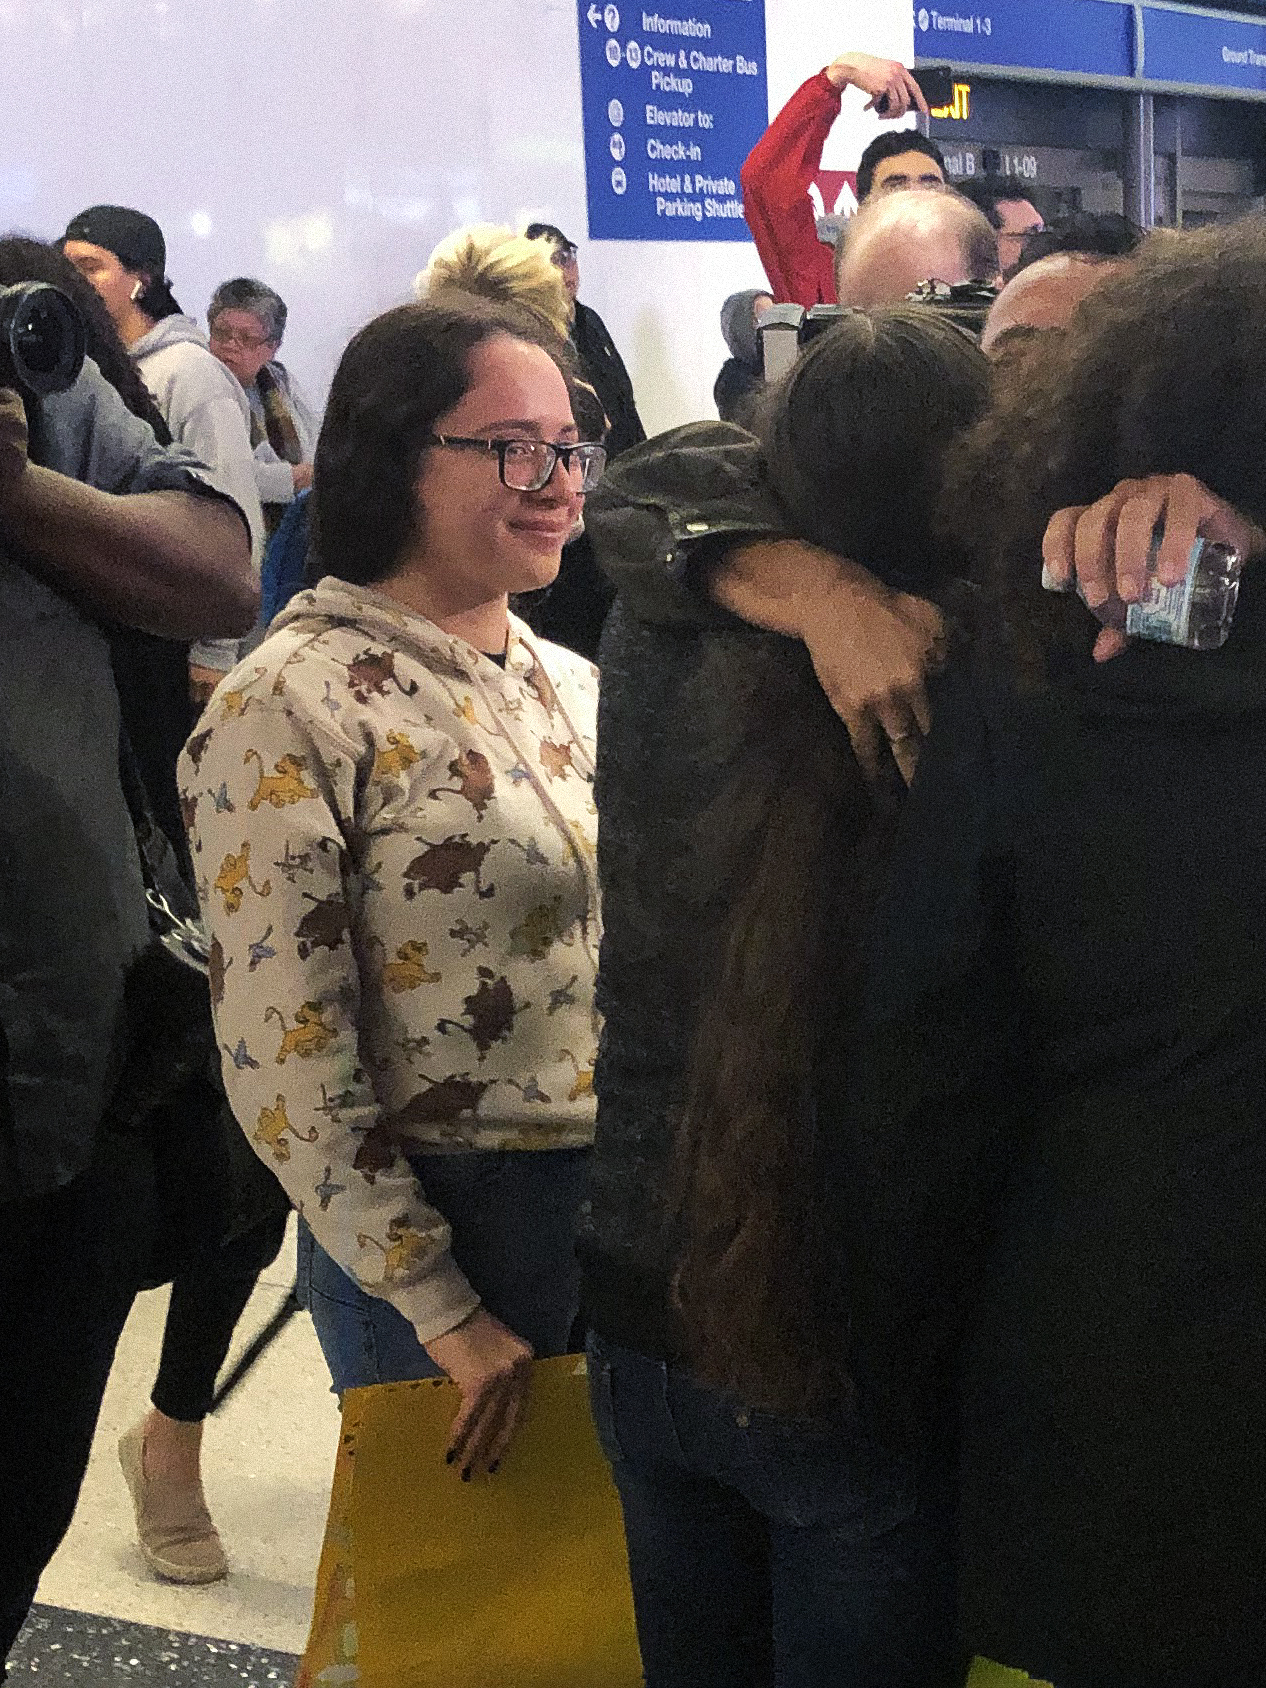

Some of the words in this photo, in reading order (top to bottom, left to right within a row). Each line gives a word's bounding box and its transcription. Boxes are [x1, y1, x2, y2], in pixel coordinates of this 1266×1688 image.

[642, 11, 711, 38] Information
[930, 9, 974, 33] Terminal
[643, 45, 676, 68] Crew
[678, 49, 688, 70] &
[689, 50, 734, 74] Charter
[735, 55, 758, 76] Bus
[651, 70, 693, 97] Pickup
[645, 104, 695, 128] Elevator
[696, 109, 714, 129] to:
[646, 138, 702, 162] Check-in
[648, 171, 682, 194] Hotel
[683, 173, 693, 194] &
[694, 174, 736, 195] Private
[656, 196, 703, 221] Parking
